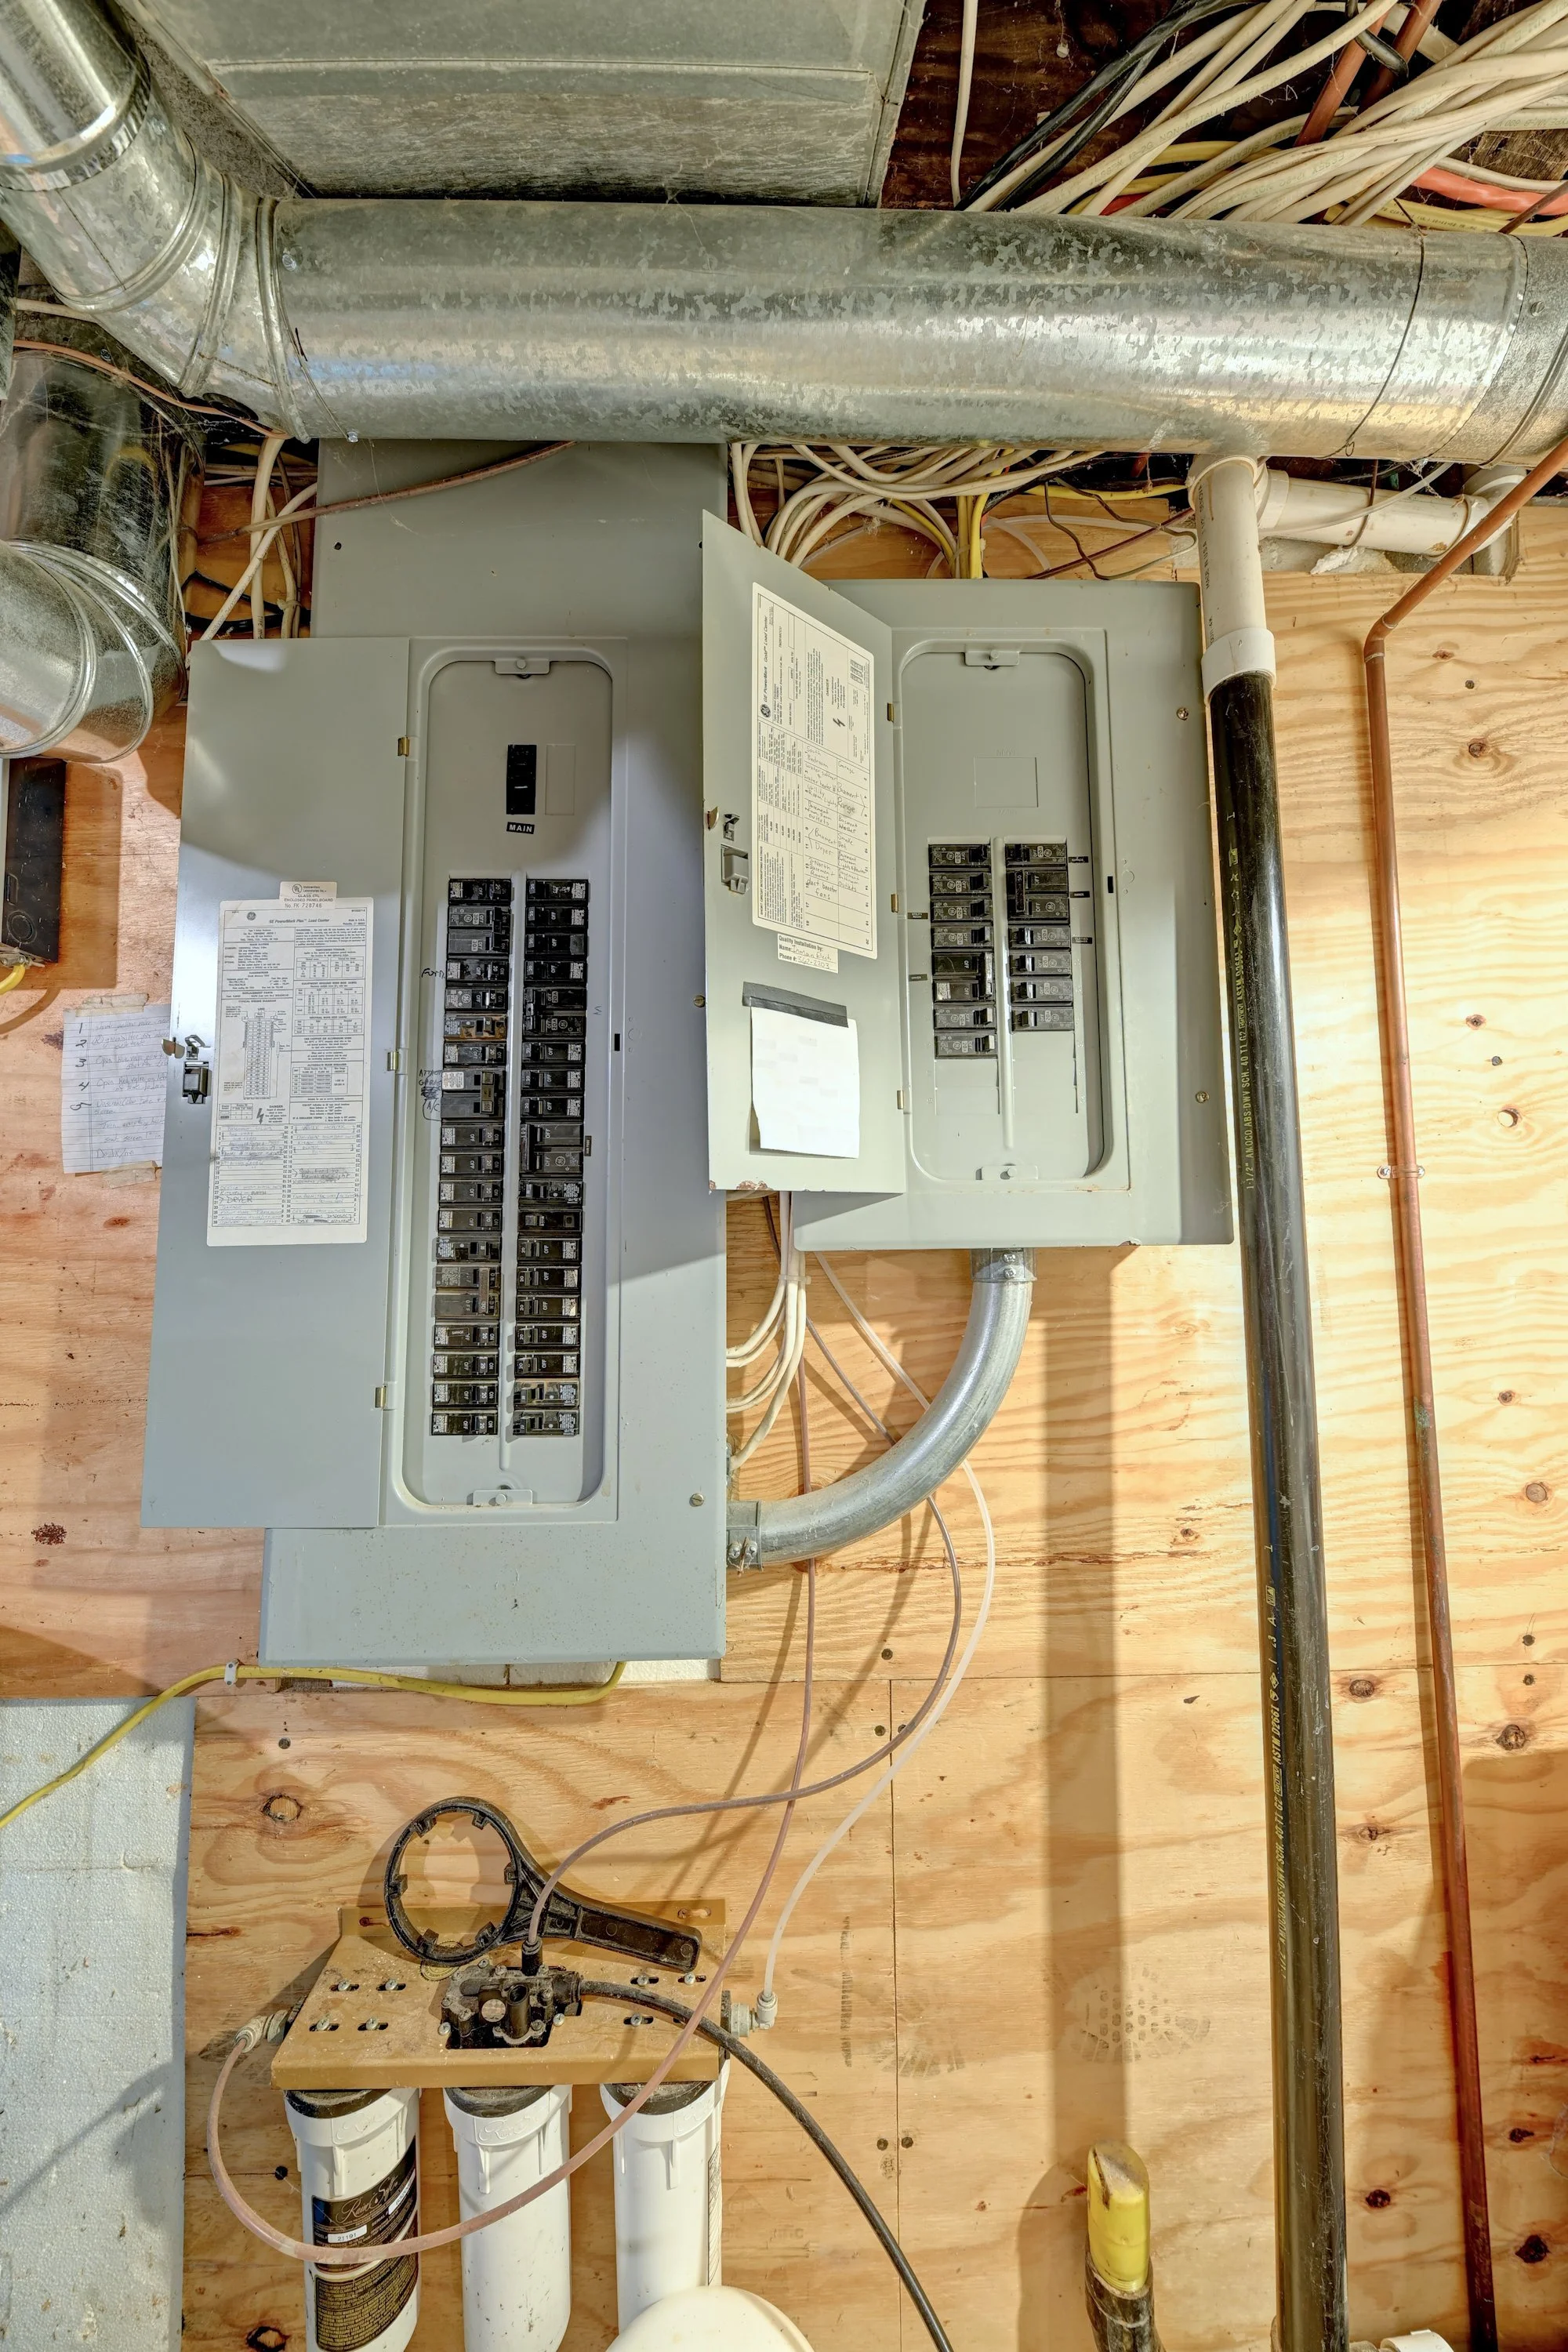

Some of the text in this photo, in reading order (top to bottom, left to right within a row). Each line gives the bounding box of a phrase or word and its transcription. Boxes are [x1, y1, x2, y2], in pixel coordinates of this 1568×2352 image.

[837, 796, 855, 813] Range
[509, 824, 532, 833] MAIN
[815, 887, 830, 900] fans
[779, 935, 793, 945] Quality
[793, 939, 816, 950] Installation
[1236, 979, 1245, 1000] ASTM
[79, 1022, 83, 1034] 1
[75, 1058, 86, 1067] 3
[1240, 1056, 1248, 1066] 40
[78, 1081, 89, 1091] 4
[1240, 1069, 1250, 1088] SCH.
[1242, 1091, 1252, 1127] ABS-DWV
[1244, 1130, 1254, 1159] AMOCO
[1270, 1706, 1280, 1737] D2661
[1272, 1736, 1281, 1765] ASTM
[337, 2232, 357, 2242] 21191
